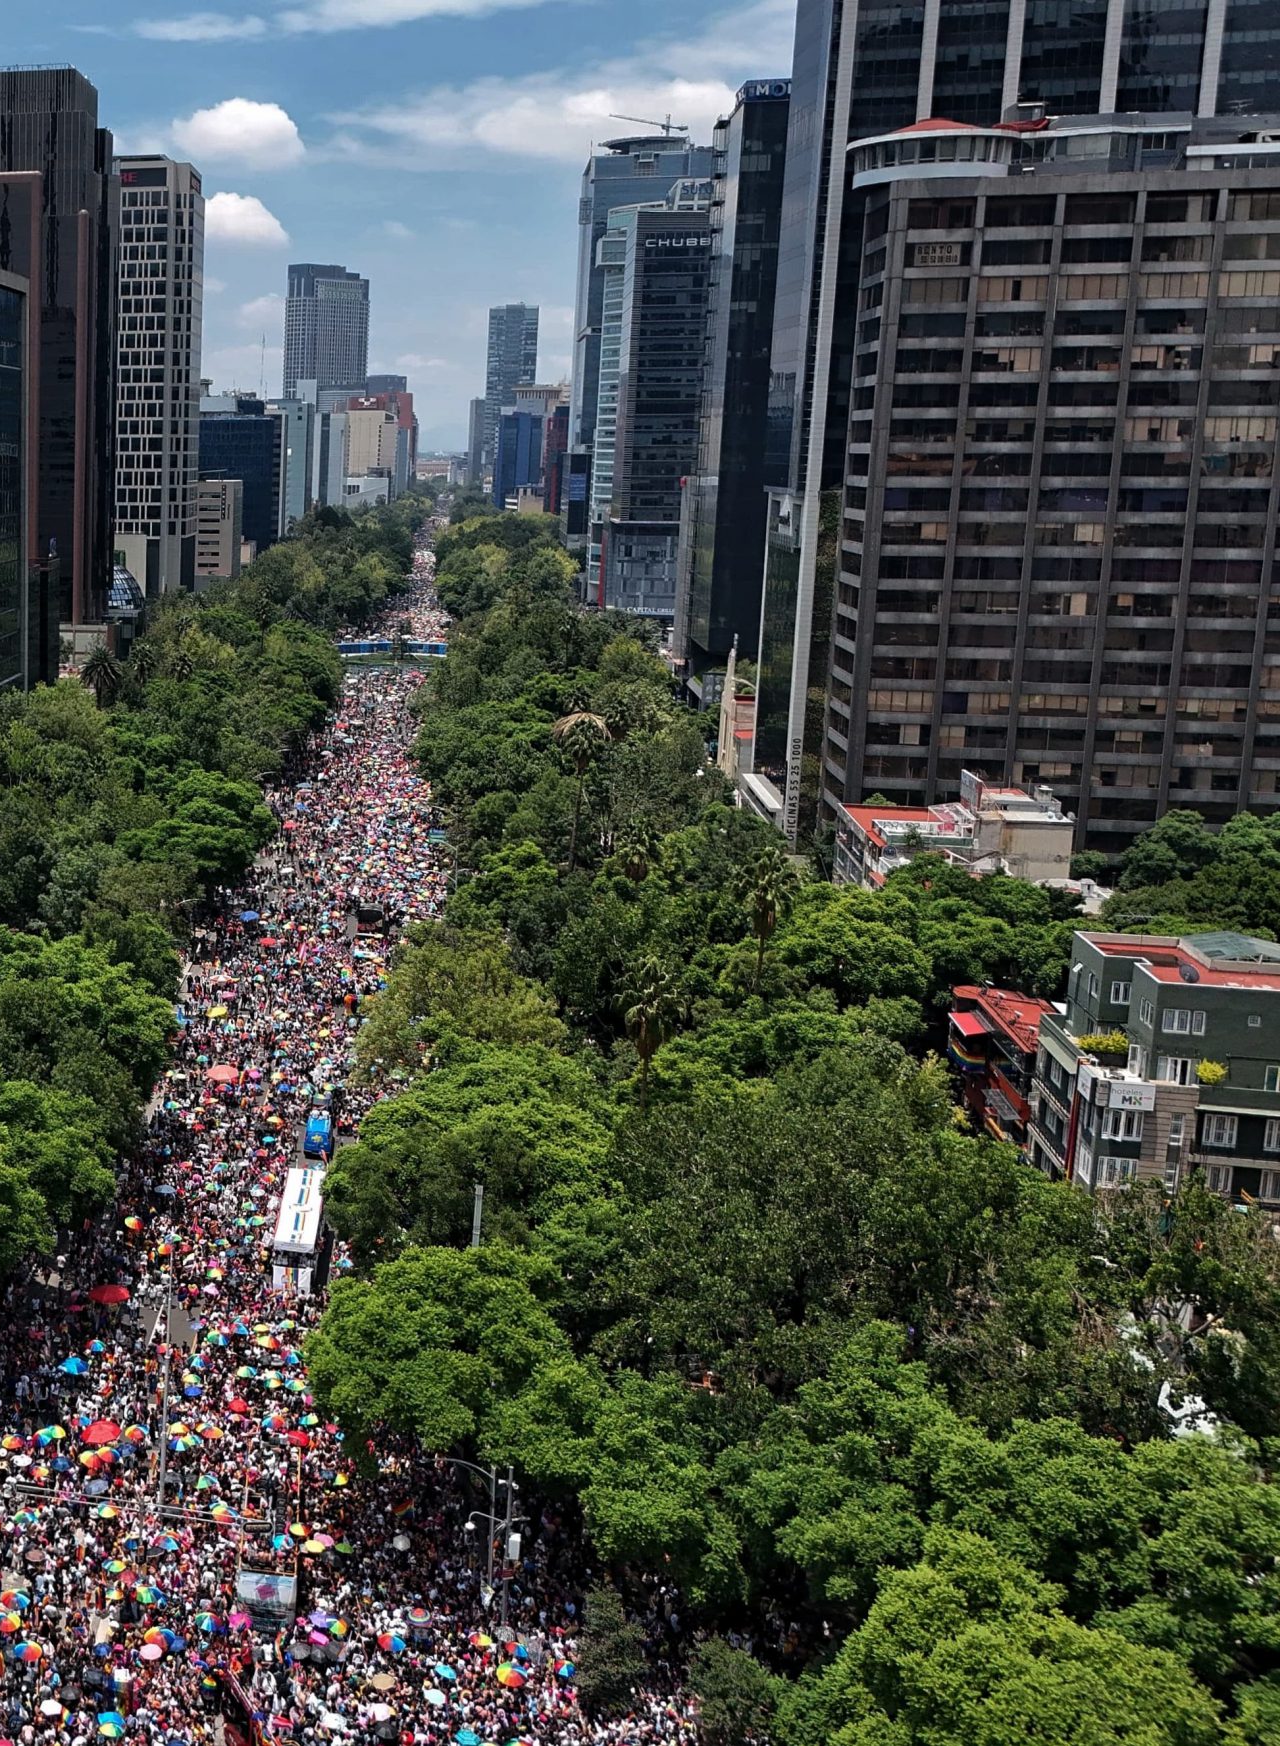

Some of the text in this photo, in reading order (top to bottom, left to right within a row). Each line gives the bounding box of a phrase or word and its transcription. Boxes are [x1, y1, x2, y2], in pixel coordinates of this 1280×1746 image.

[645, 237, 711, 247] CHUBB
[787, 738, 801, 841] OFICINAS 55 25 1000
[1111, 1087, 1143, 1097] hoteles
[1121, 1095, 1142, 1106] MX
